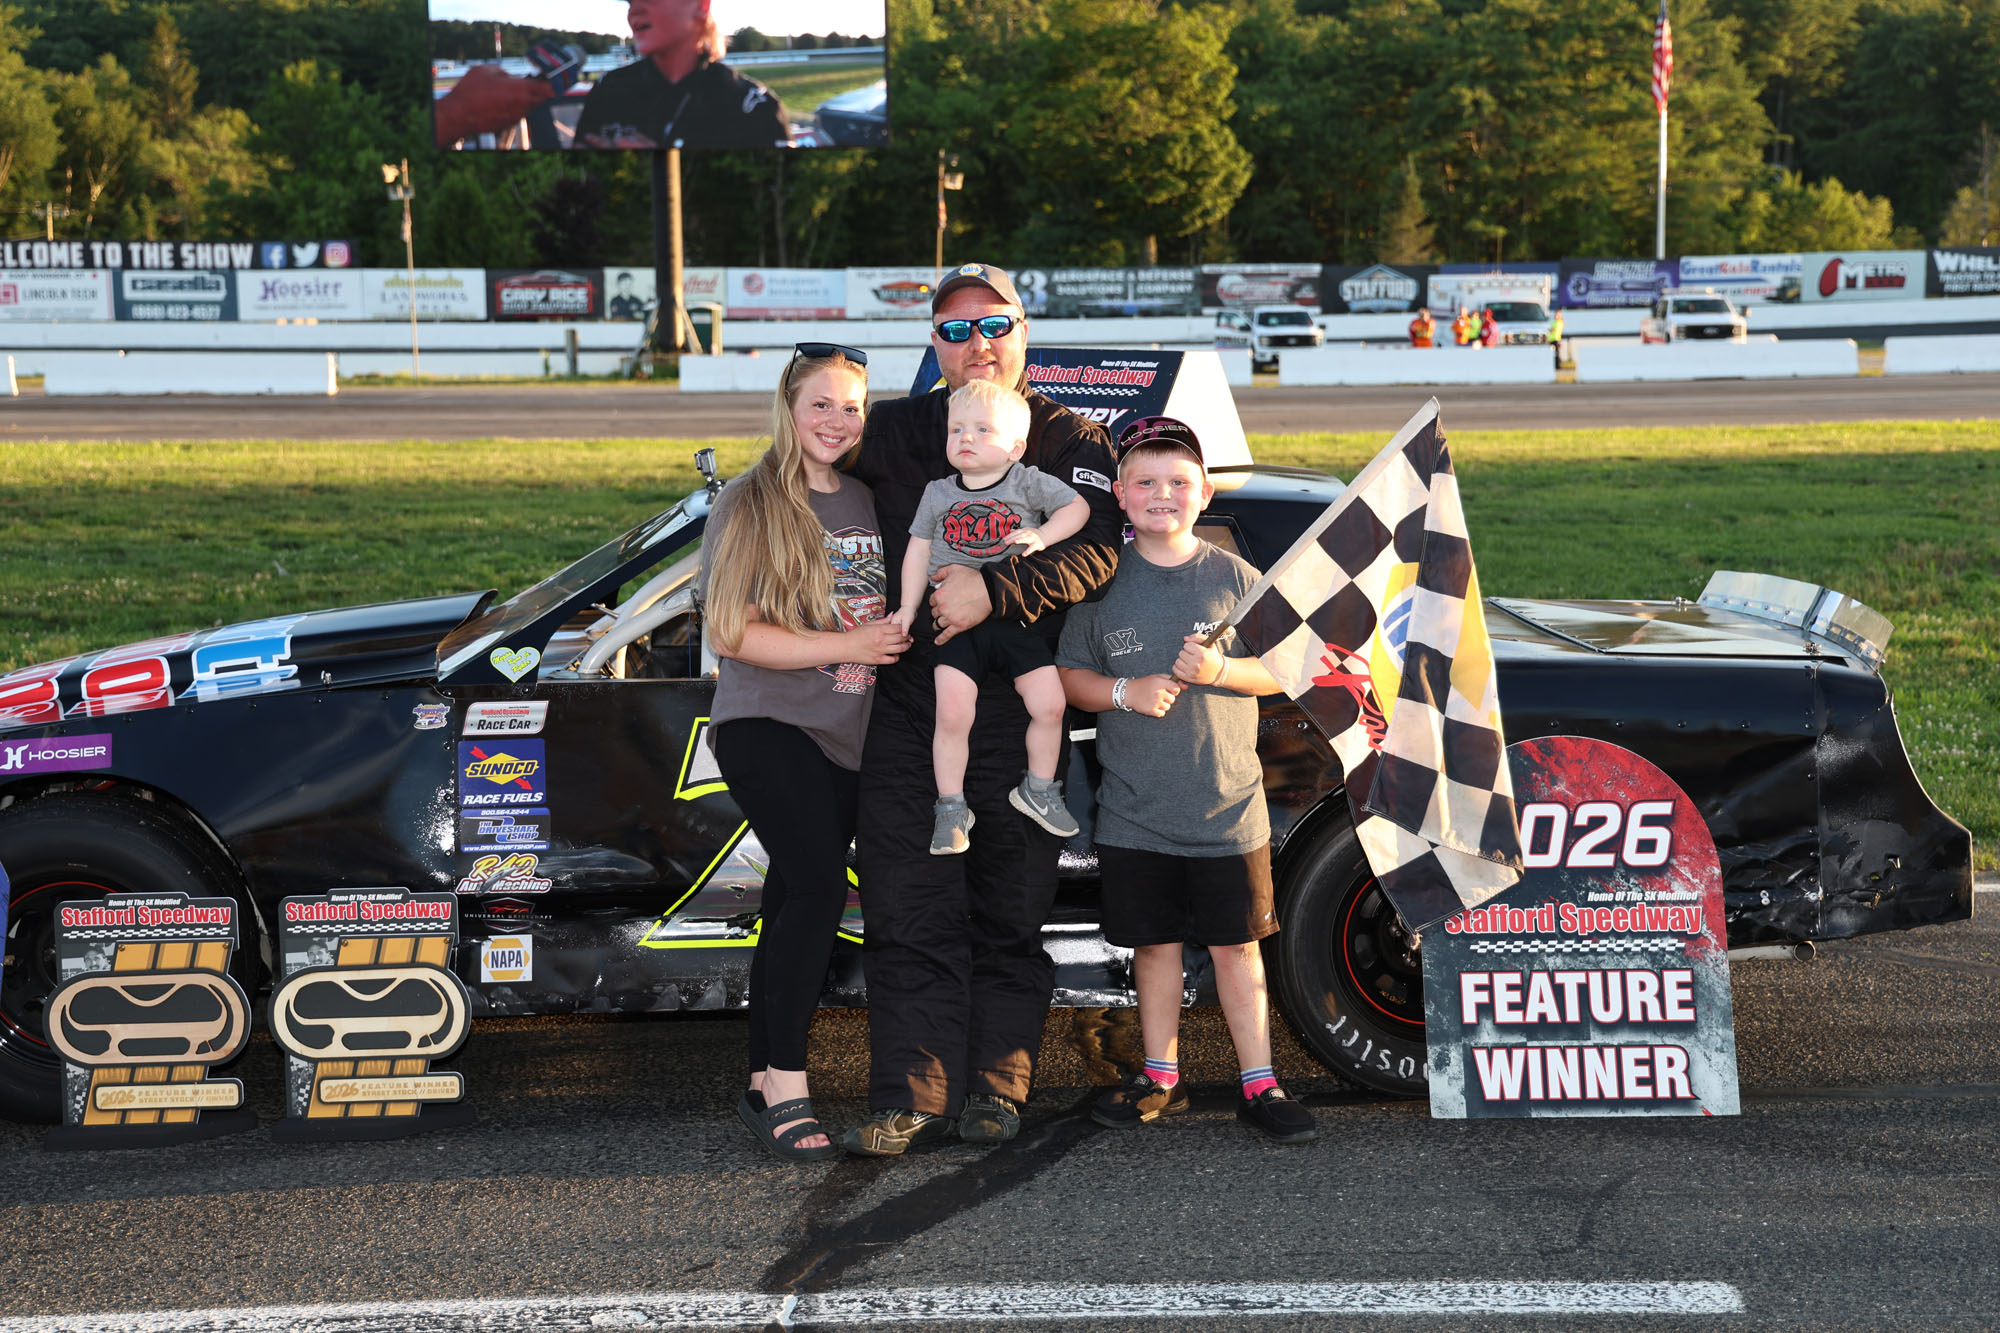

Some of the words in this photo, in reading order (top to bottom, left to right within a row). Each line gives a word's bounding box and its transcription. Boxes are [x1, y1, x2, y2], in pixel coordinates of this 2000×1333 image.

[0, 242, 84, 269] LCOME
[90, 242, 123, 269] TO
[129, 242, 175, 269] THE
[180, 242, 254, 269] SHOW
[1933, 251, 2000, 272] WHEL
[962, 265, 980, 274] NAPA
[1138, 270, 1194, 281] DEFENSE
[22, 287, 68, 300] LINCOLN
[1137, 283, 1194, 294] COMPANY
[1345, 279, 1414, 299] STAFFORD
[1027, 364, 1083, 384] Stafford
[1083, 365, 1157, 387] Speedway
[1121, 425, 1188, 446] HOOSIER
[1079, 472, 1090, 480] sfi
[1103, 628, 1144, 652] 07
[476, 719, 505, 731] RACE
[508, 718, 530, 730] CAR
[29, 746, 107, 761] HOOSIER
[469, 761, 536, 776] SUNOCO
[463, 794, 502, 805] RACE
[502, 792, 544, 803] FUELS
[478, 825, 539, 835] DRIVESHAFT
[510, 831, 540, 841] SHOP
[1519, 801, 1676, 869] 026
[491, 879, 550, 891] Machine
[108, 899, 126, 907] Home
[145, 898, 154, 906] SK
[154, 898, 181, 906] Modified
[331, 894, 348, 902] Home
[376, 893, 402, 901] Modified
[1588, 892, 1613, 902] Home
[1615, 892, 1625, 902] Of
[1626, 891, 1643, 901] The
[1644, 891, 1657, 901] SK
[1657, 891, 1698, 901] Modified
[61, 905, 135, 926] Stafford
[137, 905, 231, 926] Speedway
[286, 901, 357, 921] Stafford
[360, 900, 451, 921] Speedway
[1445, 903, 1565, 934] Stafford
[1569, 902, 1702, 935] Speedway
[491, 950, 523, 969] NAPA
[1459, 968, 1697, 1025] FEATURE
[1472, 1045, 1695, 1101] WINNER
[138, 1090, 187, 1098] FEATURE
[192, 1088, 234, 1097] WINNER
[324, 1082, 359, 1101] 2026
[361, 1082, 409, 1091] FEATURE
[414, 1081, 455, 1089] WINNER
[100, 1089, 136, 1110] 2026
